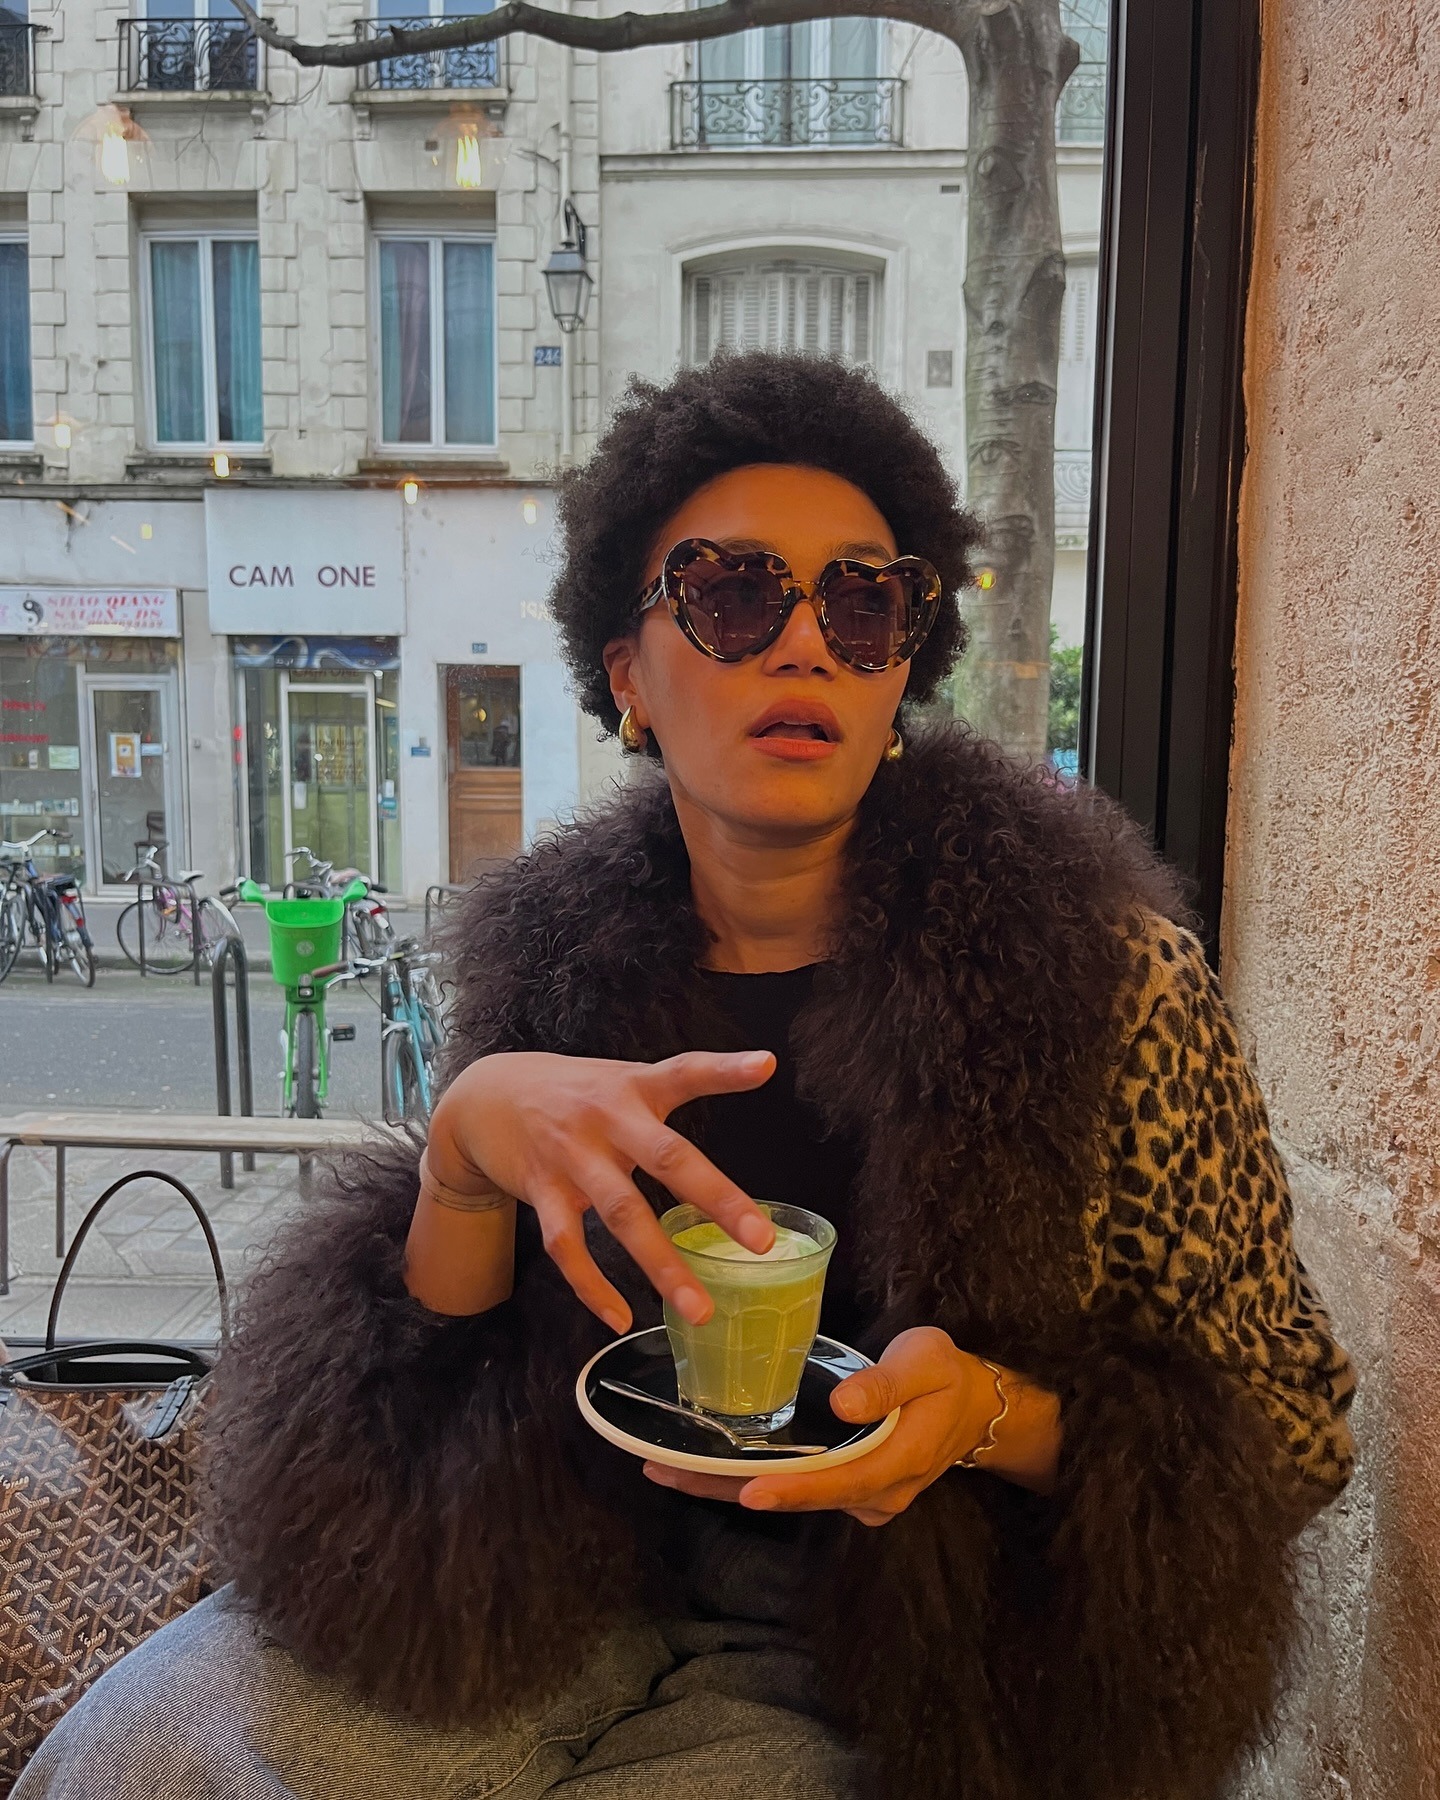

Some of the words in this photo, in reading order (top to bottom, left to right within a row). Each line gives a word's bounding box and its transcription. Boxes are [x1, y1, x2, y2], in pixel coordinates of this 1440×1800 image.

[536, 348, 560, 364] 246
[229, 565, 294, 587] CAM
[317, 565, 375, 588] ONE
